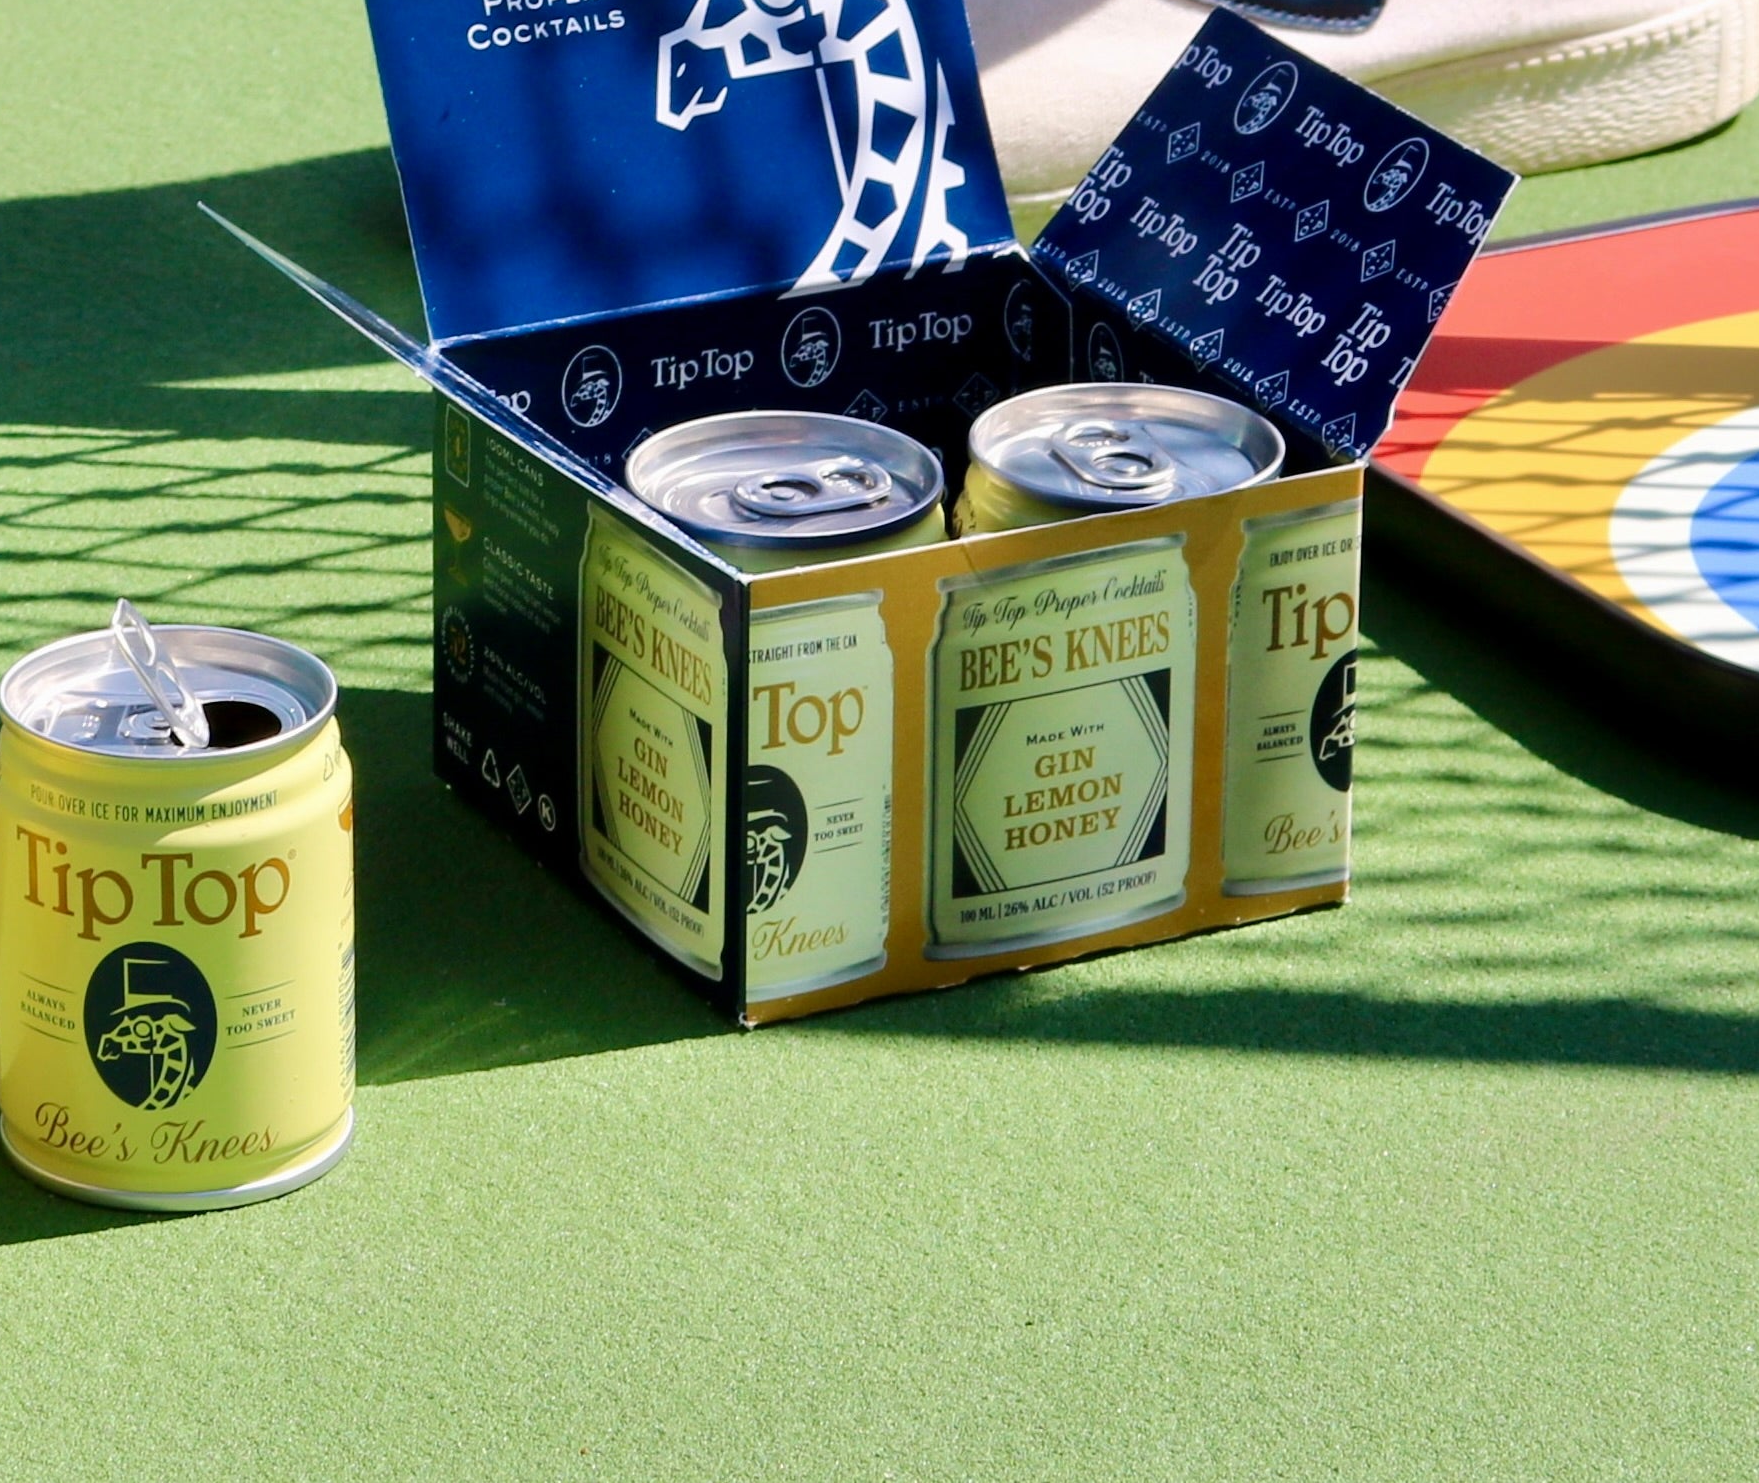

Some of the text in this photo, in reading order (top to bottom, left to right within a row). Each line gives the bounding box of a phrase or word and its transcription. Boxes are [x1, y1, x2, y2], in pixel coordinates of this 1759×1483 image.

[467, 10, 625, 51] COCKTAILS
[1194, 45, 1233, 89] Top
[1295, 104, 1365, 168] Tip Top
[1091, 145, 1132, 192] Tip
[1067, 176, 1112, 225] Top
[1200, 149, 1231, 175] 2018
[1330, 228, 1361, 253] 2018
[1425, 182, 1463, 225] Tip
[1130, 196, 1198, 258] Tip Top
[1218, 222, 1261, 273] Tip
[1192, 253, 1240, 306] Top
[1255, 274, 1327, 338] Tip Top
[1347, 302, 1391, 352] Tip
[868, 310, 973, 352] Tip Top
[651, 348, 755, 391] Tip Top
[1320, 333, 1369, 387] Top
[1296, 545, 1319, 562] OVER
[1322, 539, 1337, 556] ICE
[1340, 538, 1353, 553] OR
[963, 571, 1166, 637] Tip Top Proper Cocktails
[1262, 583, 1355, 660] Tip
[596, 585, 646, 659] BEE'S
[651, 626, 712, 706] KNEES
[798, 640, 822, 657] FROM
[826, 635, 840, 652] THE
[843, 633, 858, 649] CAN
[960, 635, 1053, 692] BEE'S
[1065, 611, 1169, 673] KNEES
[753, 681, 864, 756] Top
[1026, 723, 1105, 746] MADE WITH
[634, 737, 668, 778] GIN
[1034, 746, 1096, 779] GIN
[31, 784, 278, 824] POUR OVER ICE FOR MAXIMUM ENJOYMENT
[618, 756, 684, 823] LEMON
[1004, 772, 1123, 818] LEMON
[618, 790, 683, 856] HONEY
[814, 831, 833, 842] TOO
[1004, 806, 1122, 852] HONEY
[1264, 809, 1346, 855] Bee's
[16, 825, 290, 942] Tip Top
[1003, 901, 1030, 917] 26%
[1032, 895, 1059, 912] ALC
[1068, 888, 1094, 904] VOL
[1097, 882, 1115, 899] (52
[1118, 870, 1157, 893] PROOF)
[751, 916, 850, 961] Knees
[20, 1001, 76, 1031] BALANCED
[27, 989, 66, 1012] ALWAYS
[226, 1010, 296, 1036] TOO SWEET
[242, 998, 281, 1017] NEVER
[35, 1102, 279, 1164] Bee's Knees
